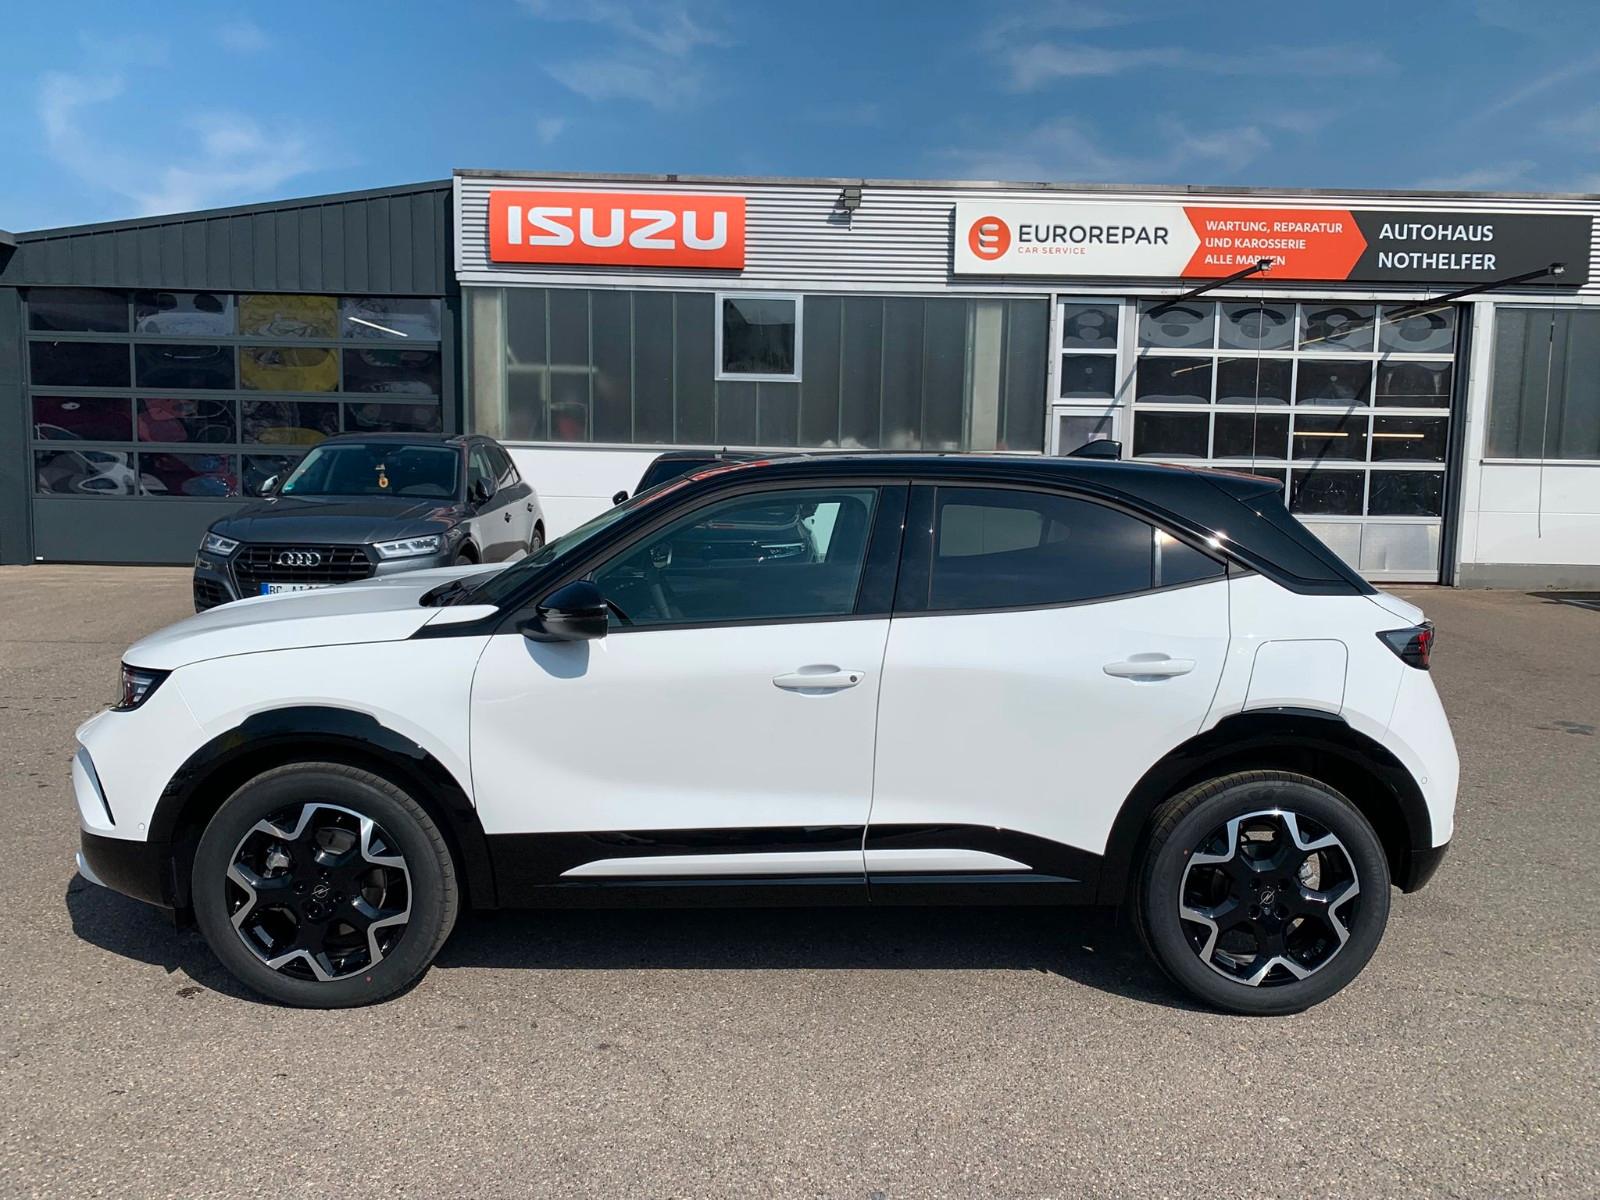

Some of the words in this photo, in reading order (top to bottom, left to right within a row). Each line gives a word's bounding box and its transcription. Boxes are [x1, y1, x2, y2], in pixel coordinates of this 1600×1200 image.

[507, 205, 728, 251] ISUZU
[1018, 224, 1169, 245] EUROREPAR
[1205, 220, 1271, 233] WARTUNG,
[1273, 221, 1343, 233] REPARATUR
[1379, 223, 1494, 242] AUTOHAUS
[1041, 247, 1086, 255] SERVICE
[1205, 237, 1232, 248] UND
[1234, 238, 1307, 249] KAROSSERIE
[1204, 254, 1233, 265] ALLE
[1378, 251, 1496, 270] NOTHELFER
